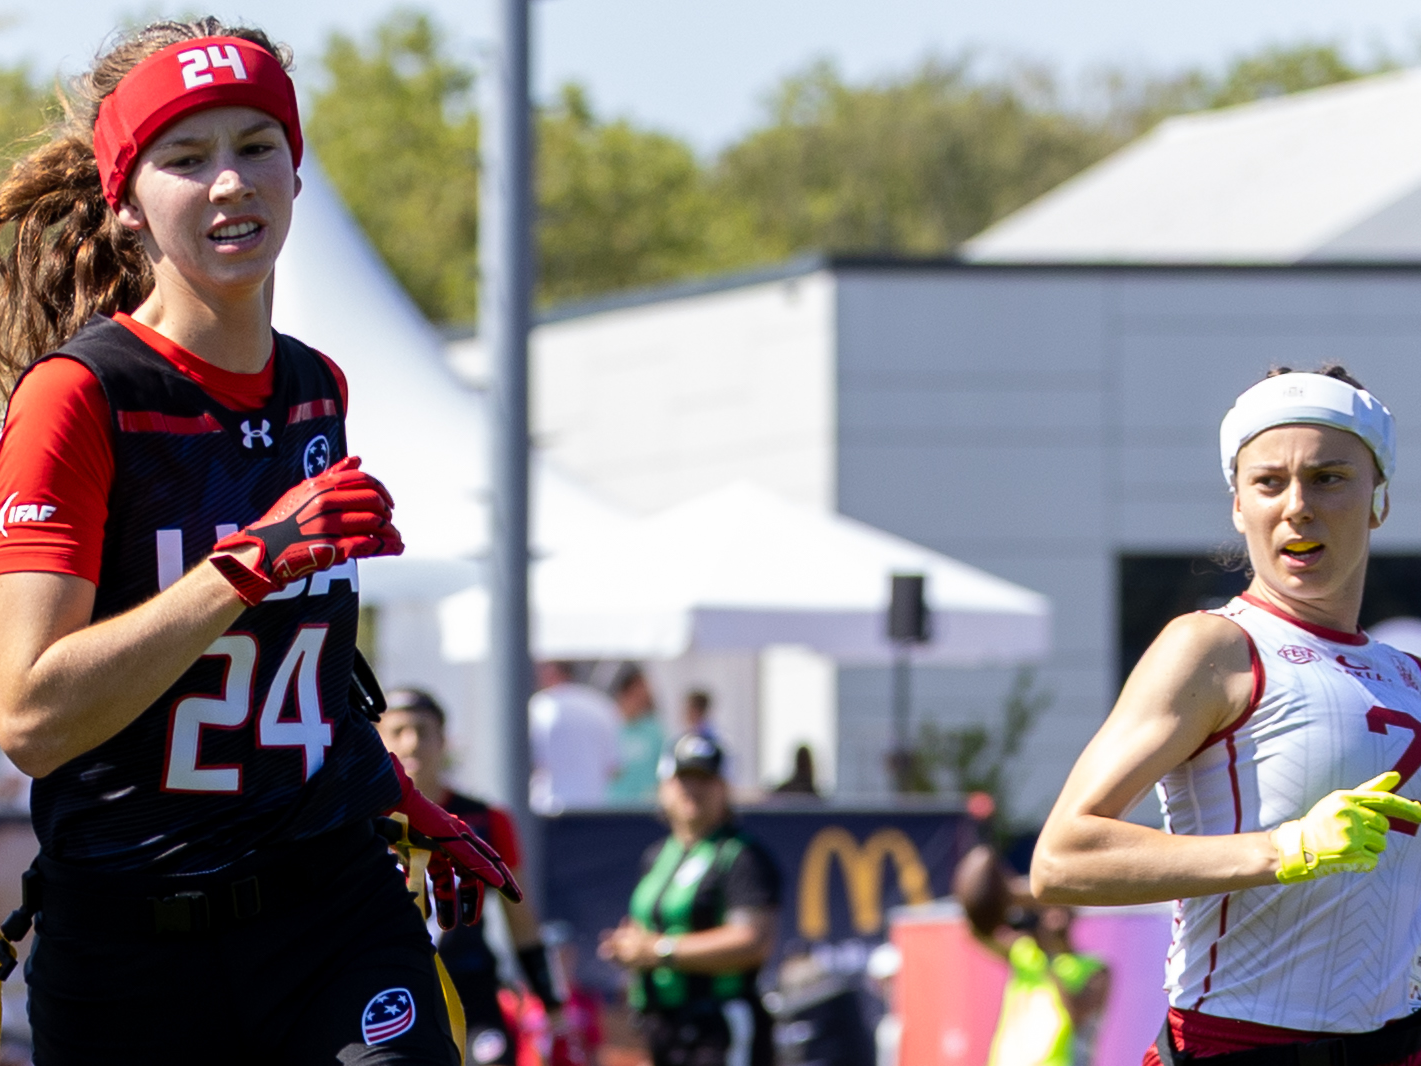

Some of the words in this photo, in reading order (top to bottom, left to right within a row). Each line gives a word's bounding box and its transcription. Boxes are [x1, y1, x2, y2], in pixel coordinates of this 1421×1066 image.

[177, 44, 248, 90] 24
[8, 503, 57, 523] IFAF
[160, 623, 334, 794] 24
